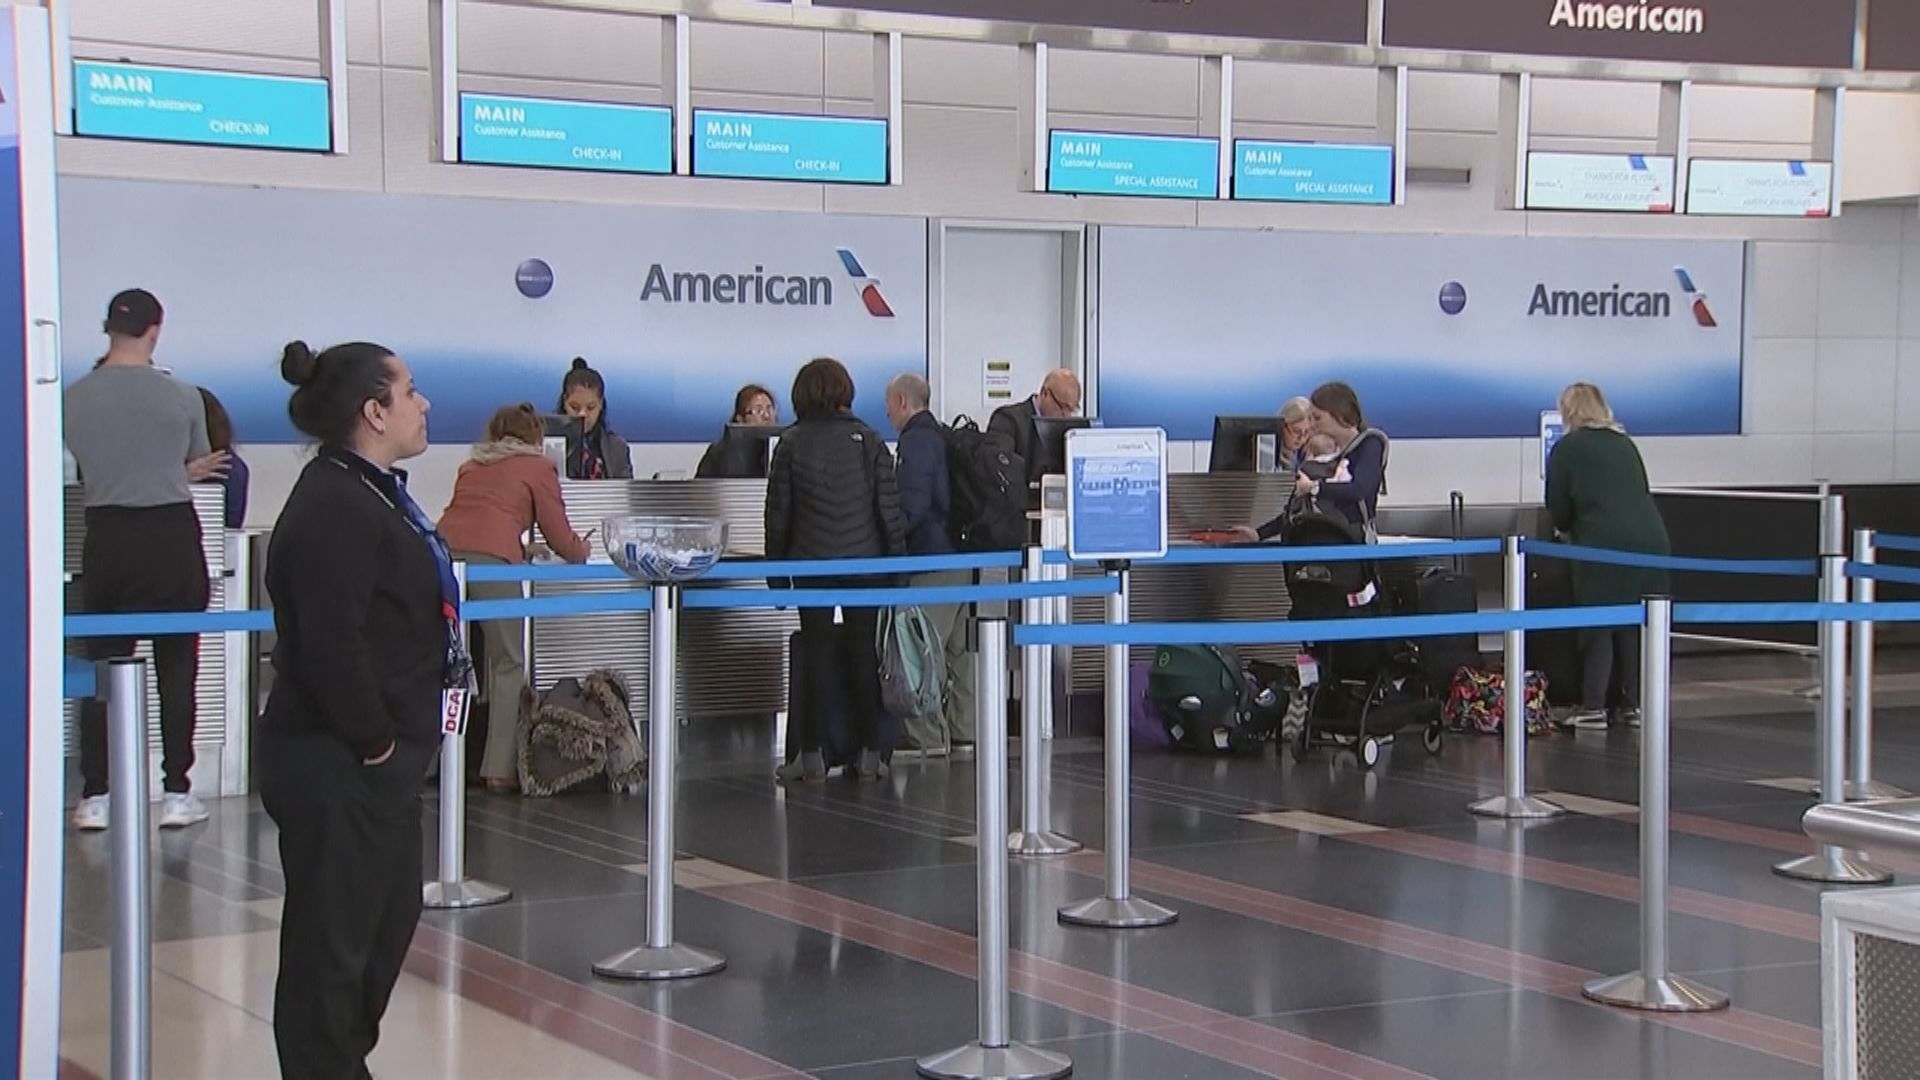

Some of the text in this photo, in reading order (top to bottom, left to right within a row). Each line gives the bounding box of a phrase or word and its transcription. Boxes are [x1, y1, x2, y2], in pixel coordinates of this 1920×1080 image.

[1549, 0, 1703, 33] American
[90, 71, 152, 92] MAIN
[90, 93, 204, 113] Customer Assistance
[474, 104, 525, 123] MAIN
[209, 119, 270, 136] CHECK-IN
[474, 123, 566, 140] Customer Assistance
[706, 122, 752, 137] MAIN
[706, 138, 789, 153] Customer Assistance
[1061, 141, 1100, 156] MAIN
[572, 146, 622, 161] CHECK-IN
[1245, 150, 1282, 164] MAIN
[795, 159, 840, 171] CHECK-IN
[1060, 157, 1133, 170] Customer Assistance
[1244, 165, 1312, 178] Customer Assistance
[1115, 174, 1199, 189] SPECIAL ASSISTANCE
[1295, 181, 1374, 195] SPECIAL ASSISTANCE
[639, 263, 832, 306] American
[1527, 283, 1670, 317] American
[444, 691, 461, 732] DCA
